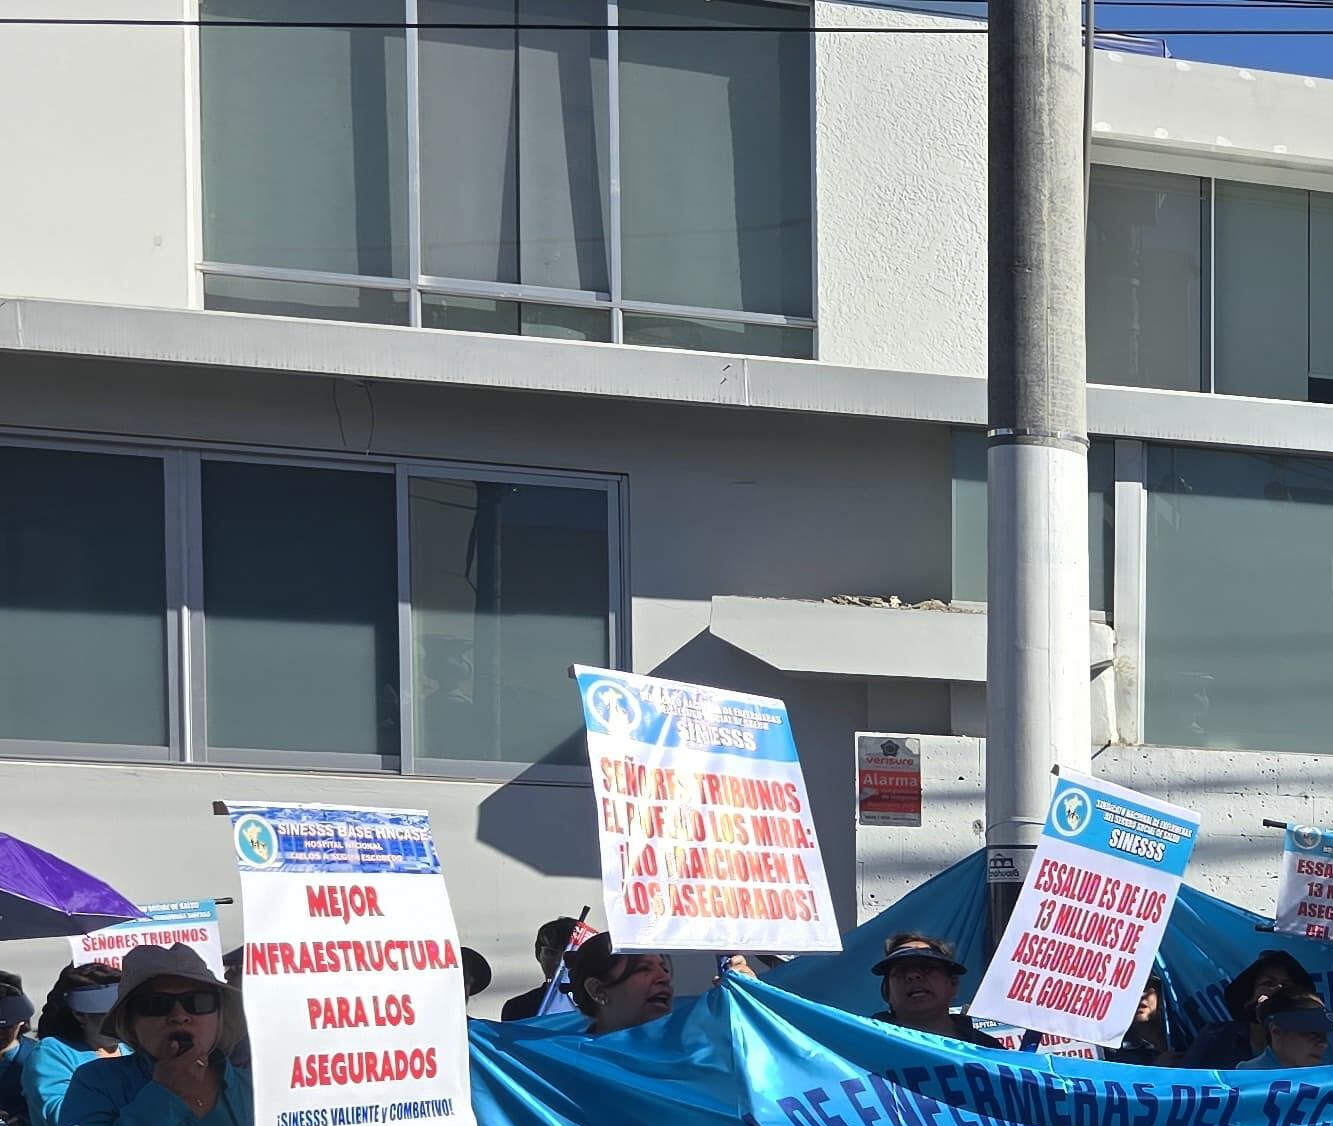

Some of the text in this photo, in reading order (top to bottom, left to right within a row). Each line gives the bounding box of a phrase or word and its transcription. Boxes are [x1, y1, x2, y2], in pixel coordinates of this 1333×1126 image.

[695, 773, 800, 813] TRIBUNOS
[863, 774, 918, 785] Alarma
[278, 824, 334, 837] SINESSS
[338, 825, 372, 839] BASE
[602, 798, 814, 849] EL LOS MIRA:
[665, 845, 790, 883] TRAICIONEN
[792, 853, 809, 884] A
[1109, 828, 1166, 862] SINESSS
[306, 885, 384, 924] MEJOR
[623, 881, 819, 921] LOS ASEGURADOS!
[1034, 858, 1167, 923] ESSALUD ES DE LOS
[1307, 881, 1324, 897] 13
[82, 928, 208, 951] SEÑORES TRIBUNOS
[1034, 898, 1144, 955] 13 MILLONES DE
[1306, 923, 1330, 939] DEL
[246, 939, 459, 975] INFRAESTRUCTURA
[1011, 932, 1136, 990] ASEGURADOS, NO
[307, 994, 415, 1029] PARA LOS
[1007, 969, 1113, 1021] DEL GOBIERNO
[290, 1047, 437, 1088] ASEGURADOS
[330, 1105, 379, 1126] VALIENTE
[382, 1107, 388, 1123] y
[389, 1098, 454, 1120] COMBATIVO!
